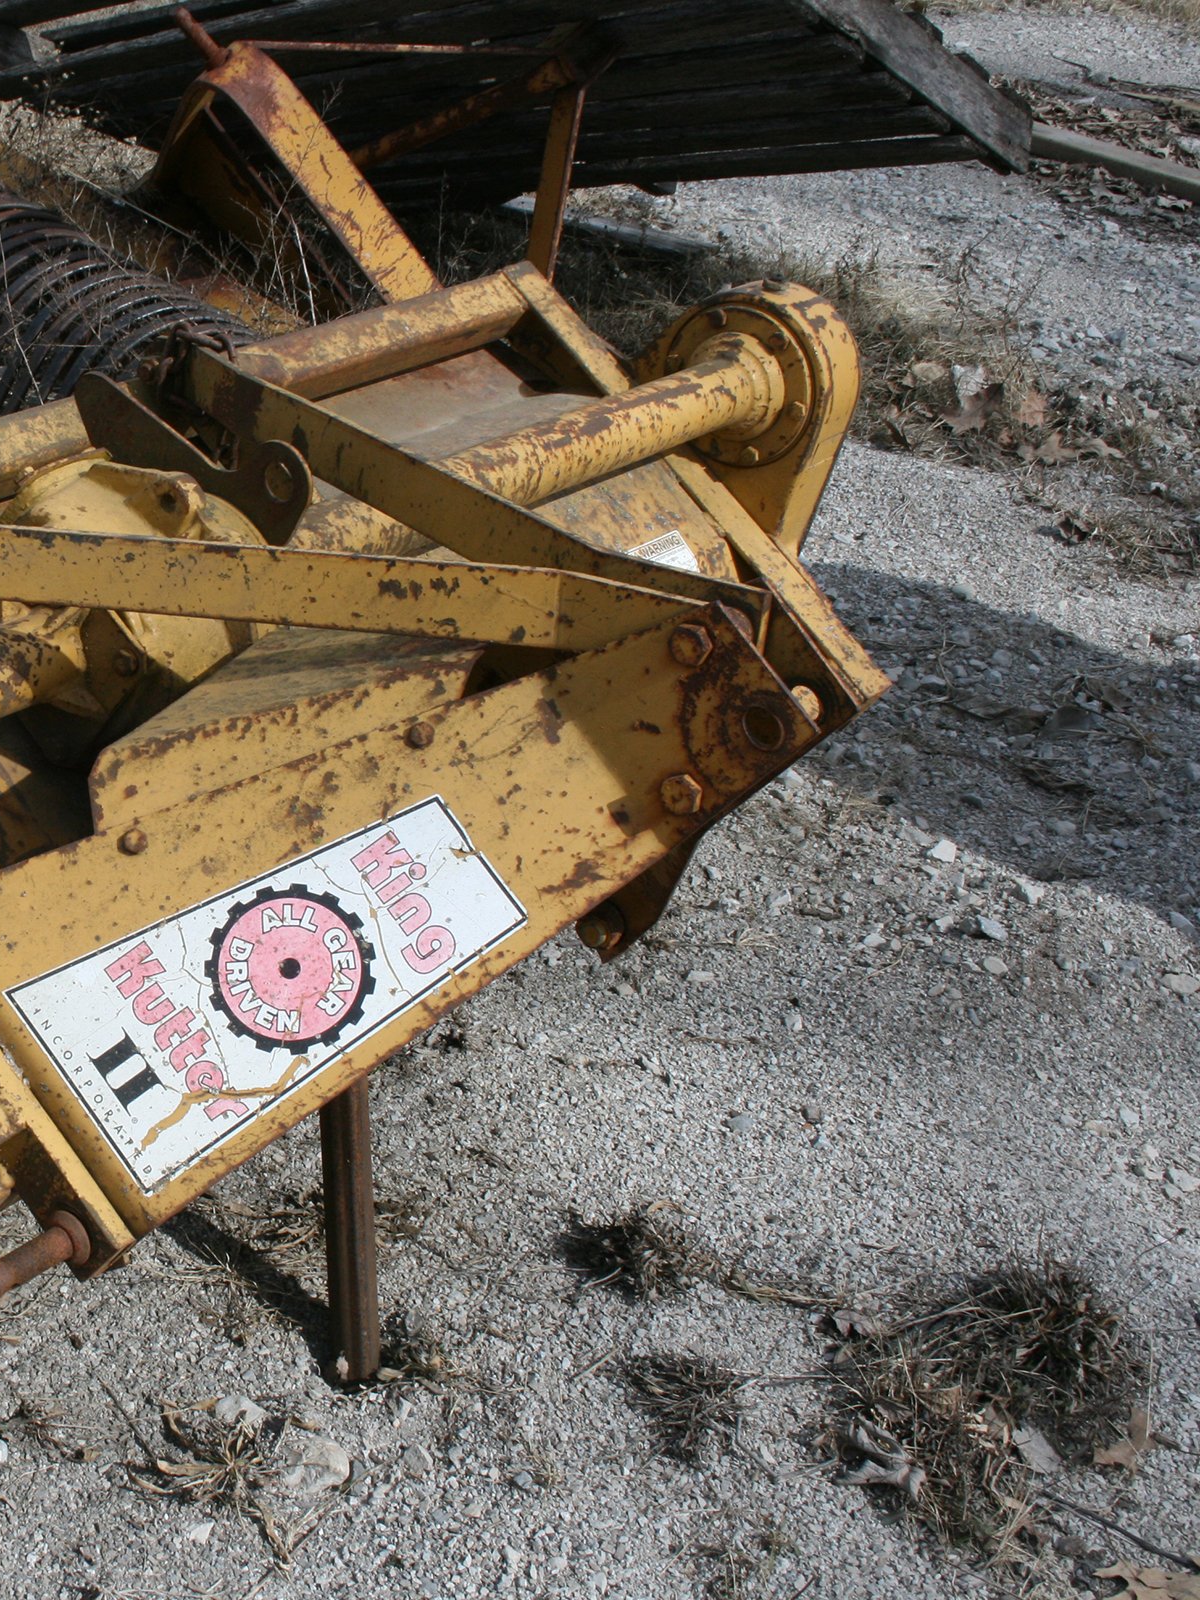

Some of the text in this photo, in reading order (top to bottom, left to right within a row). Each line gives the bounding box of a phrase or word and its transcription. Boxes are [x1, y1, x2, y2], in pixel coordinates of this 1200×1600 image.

[639, 535, 680, 559] WARNING
[225, 903, 357, 1034] ALL GEAR DRIVEN
[350, 831, 457, 975] King
[33, 1007, 153, 1175] INCORPORATED
[104, 940, 250, 1122] Kutter
